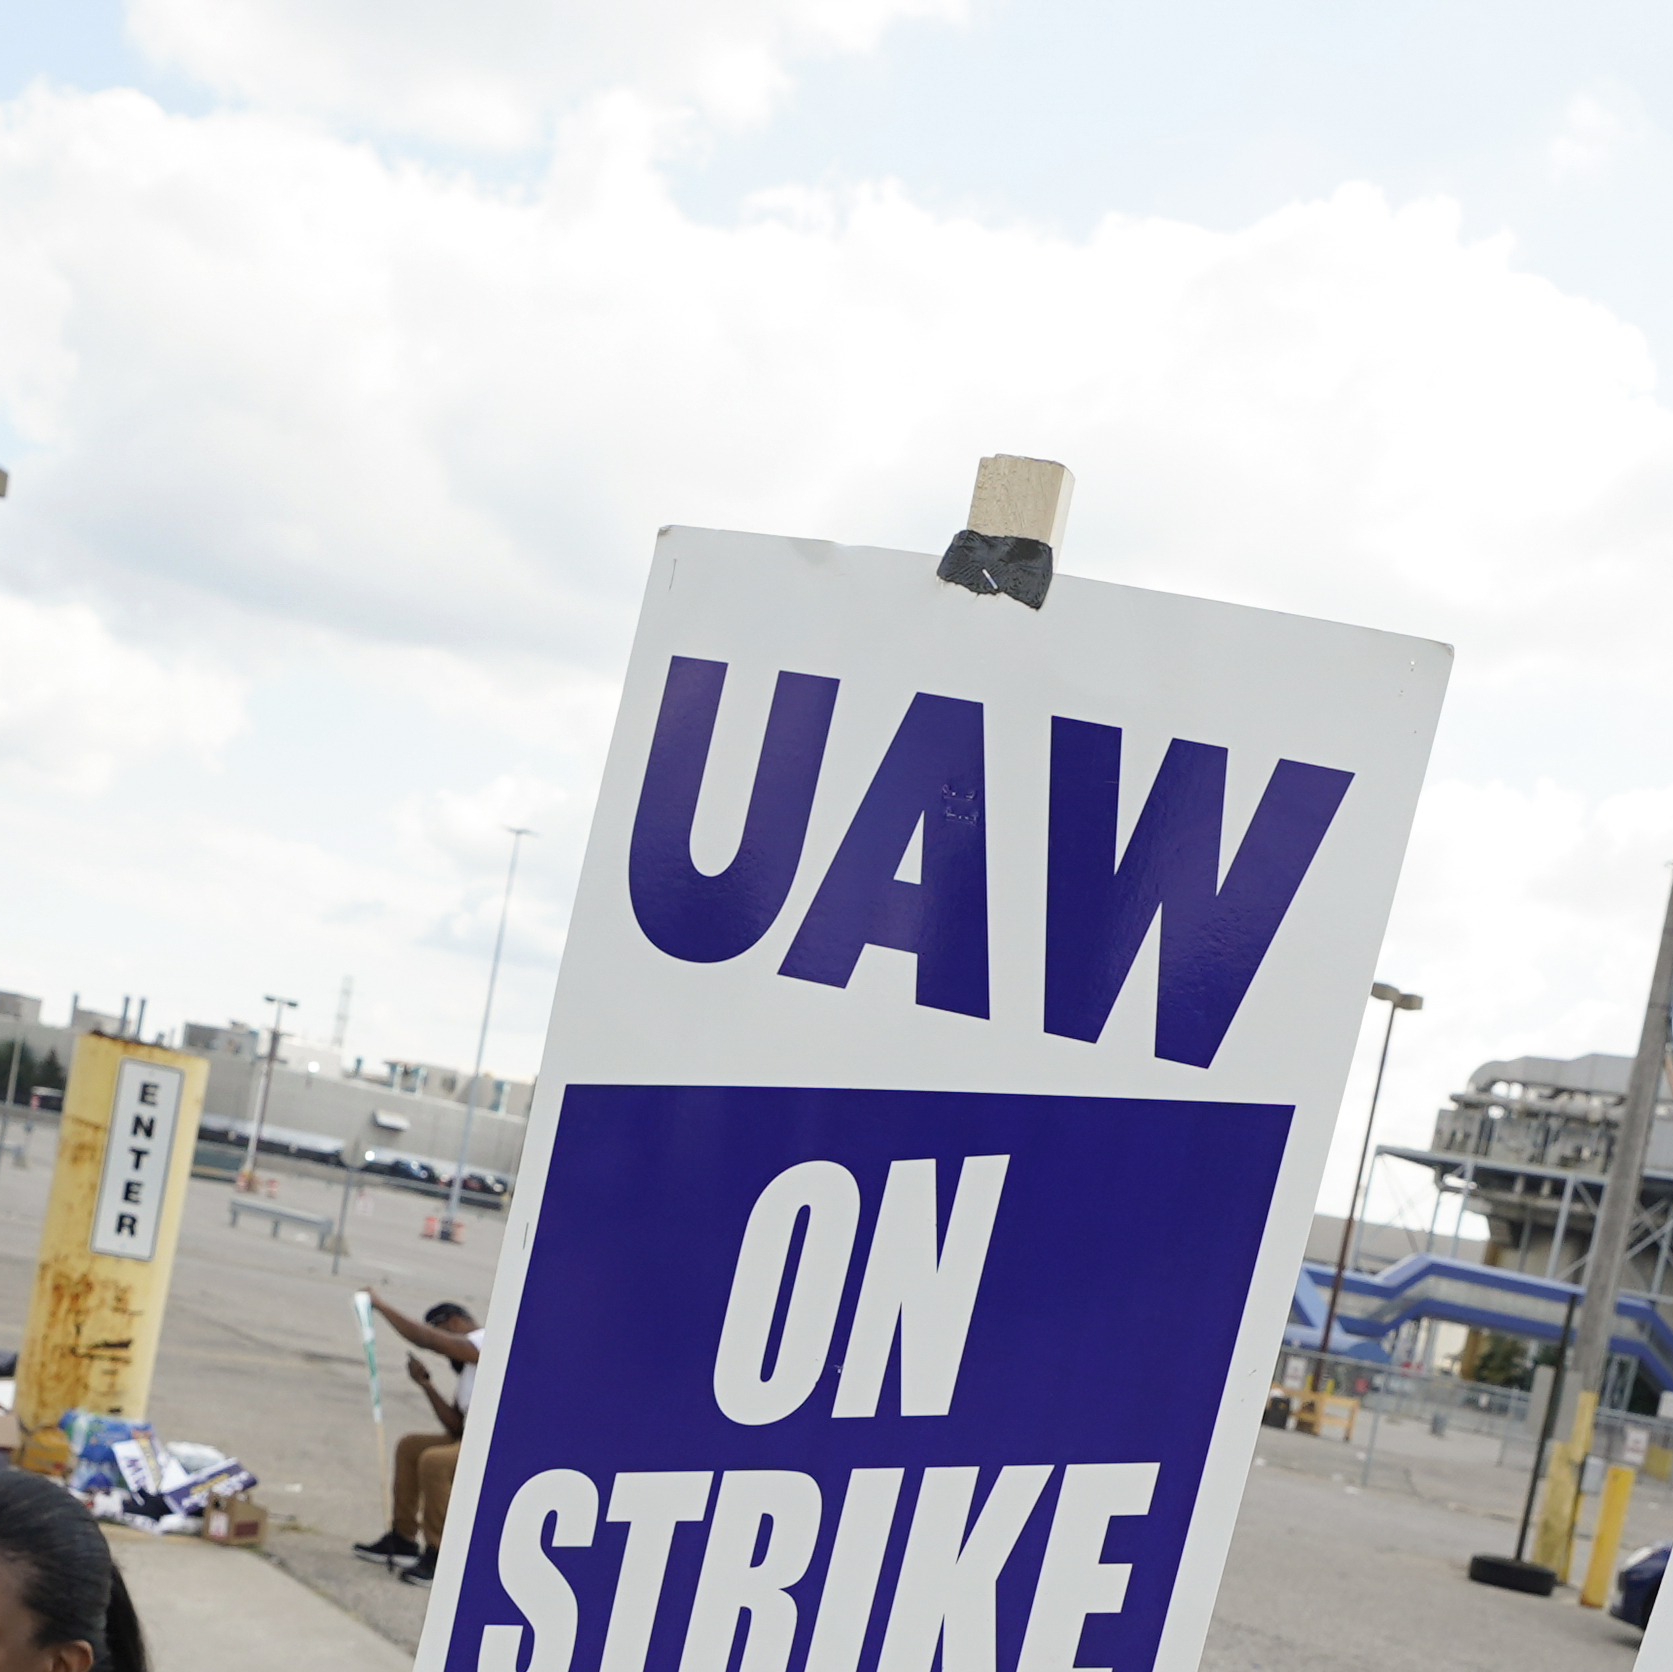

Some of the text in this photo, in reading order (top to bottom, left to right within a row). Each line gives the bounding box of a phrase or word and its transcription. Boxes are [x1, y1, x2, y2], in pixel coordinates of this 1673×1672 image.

[628, 654, 1355, 1070] UAW
[113, 1080, 160, 1238] ENTER
[713, 1154, 1011, 1427] ON
